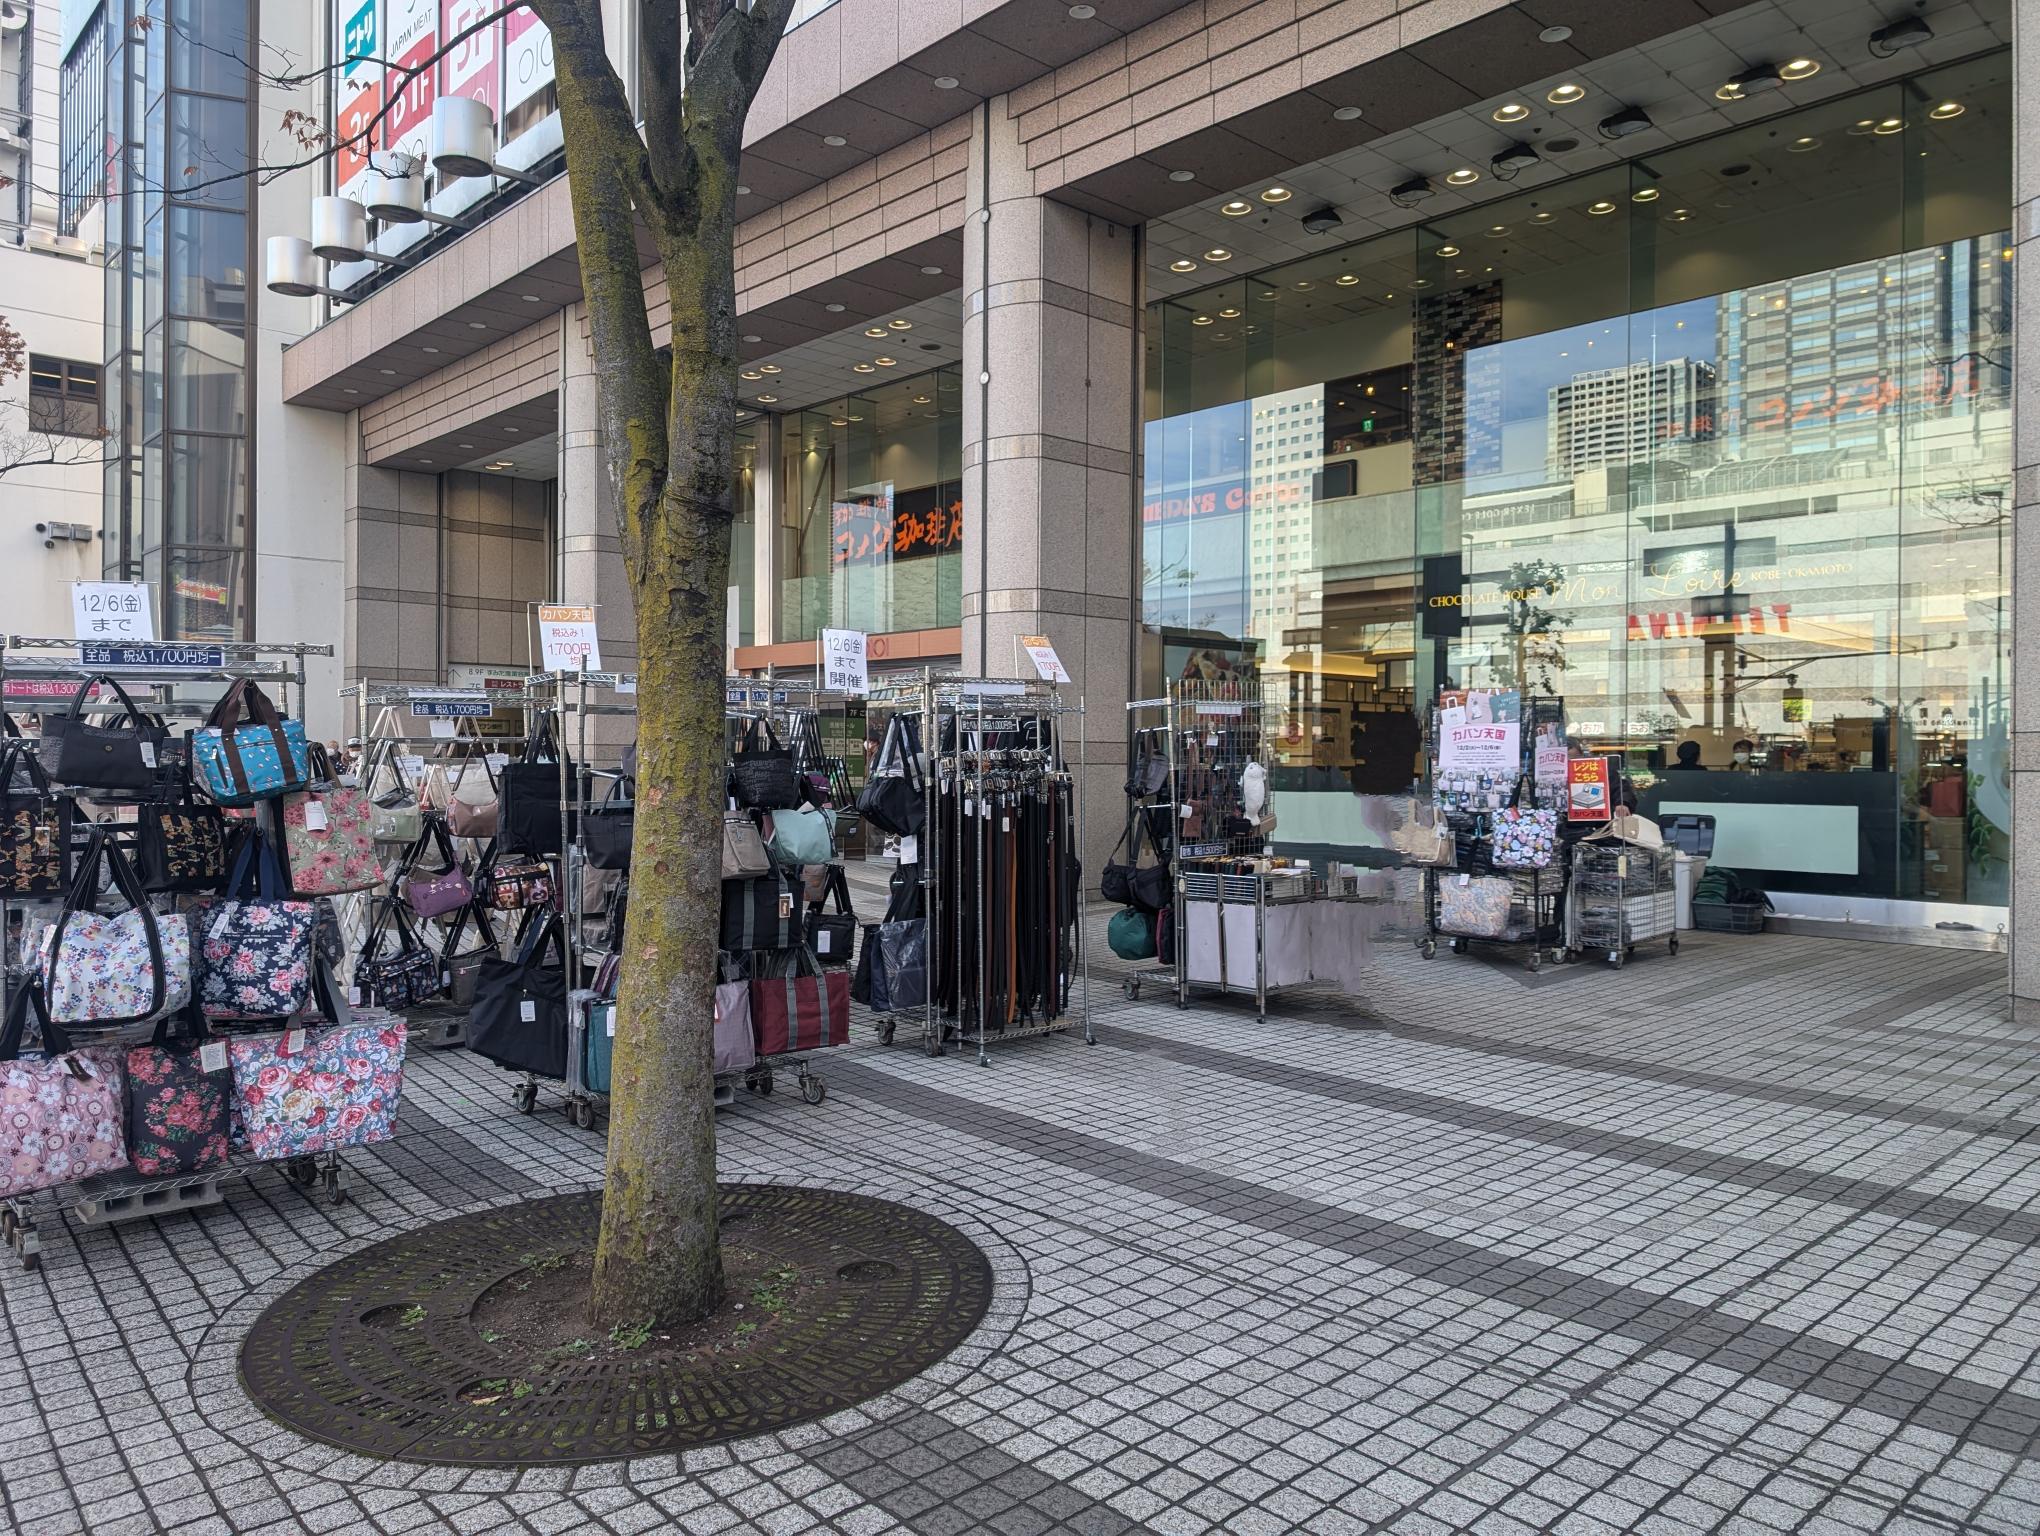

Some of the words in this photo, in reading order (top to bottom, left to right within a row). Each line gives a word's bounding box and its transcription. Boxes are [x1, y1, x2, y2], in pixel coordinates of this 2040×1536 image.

[347, 10, 374, 56] ニトリ
[389, 26, 412, 57] JAPAN
[80, 594, 142, 612] 12/6(金)
[1429, 592, 1501, 608] CHOCOLATE
[1504, 586, 1544, 601] HOUSE
[91, 617, 132, 632] まで
[85, 648, 111, 663] 全品
[833, 656, 857, 670] まで
[829, 671, 863, 688] 開催
[414, 704, 429, 714] 全品
[1452, 727, 1506, 741] カバン天国
[1572, 761, 1600, 772] レジは
[1574, 772, 1600, 783] こちら
